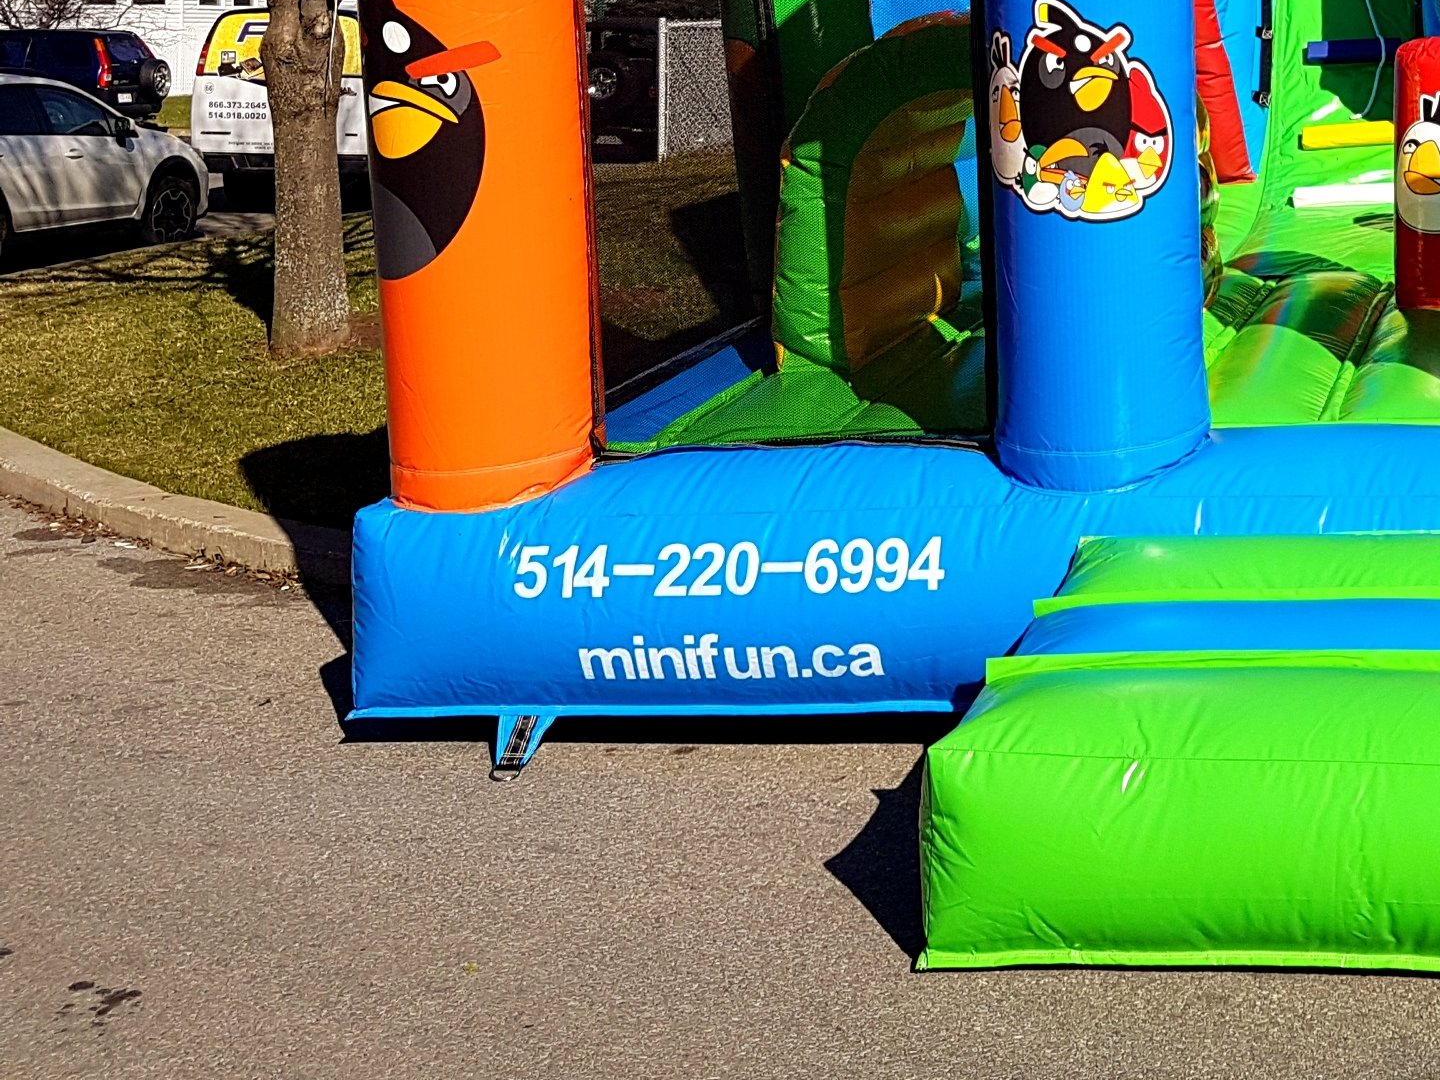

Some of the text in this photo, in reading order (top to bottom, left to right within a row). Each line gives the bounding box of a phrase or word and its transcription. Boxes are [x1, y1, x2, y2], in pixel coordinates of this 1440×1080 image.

[208, 101, 267, 110] 866.373.2645
[208, 111, 267, 120] 514.918.0020
[513, 536, 945, 598] 514-220-6994
[578, 633, 885, 680] minifun.ca
